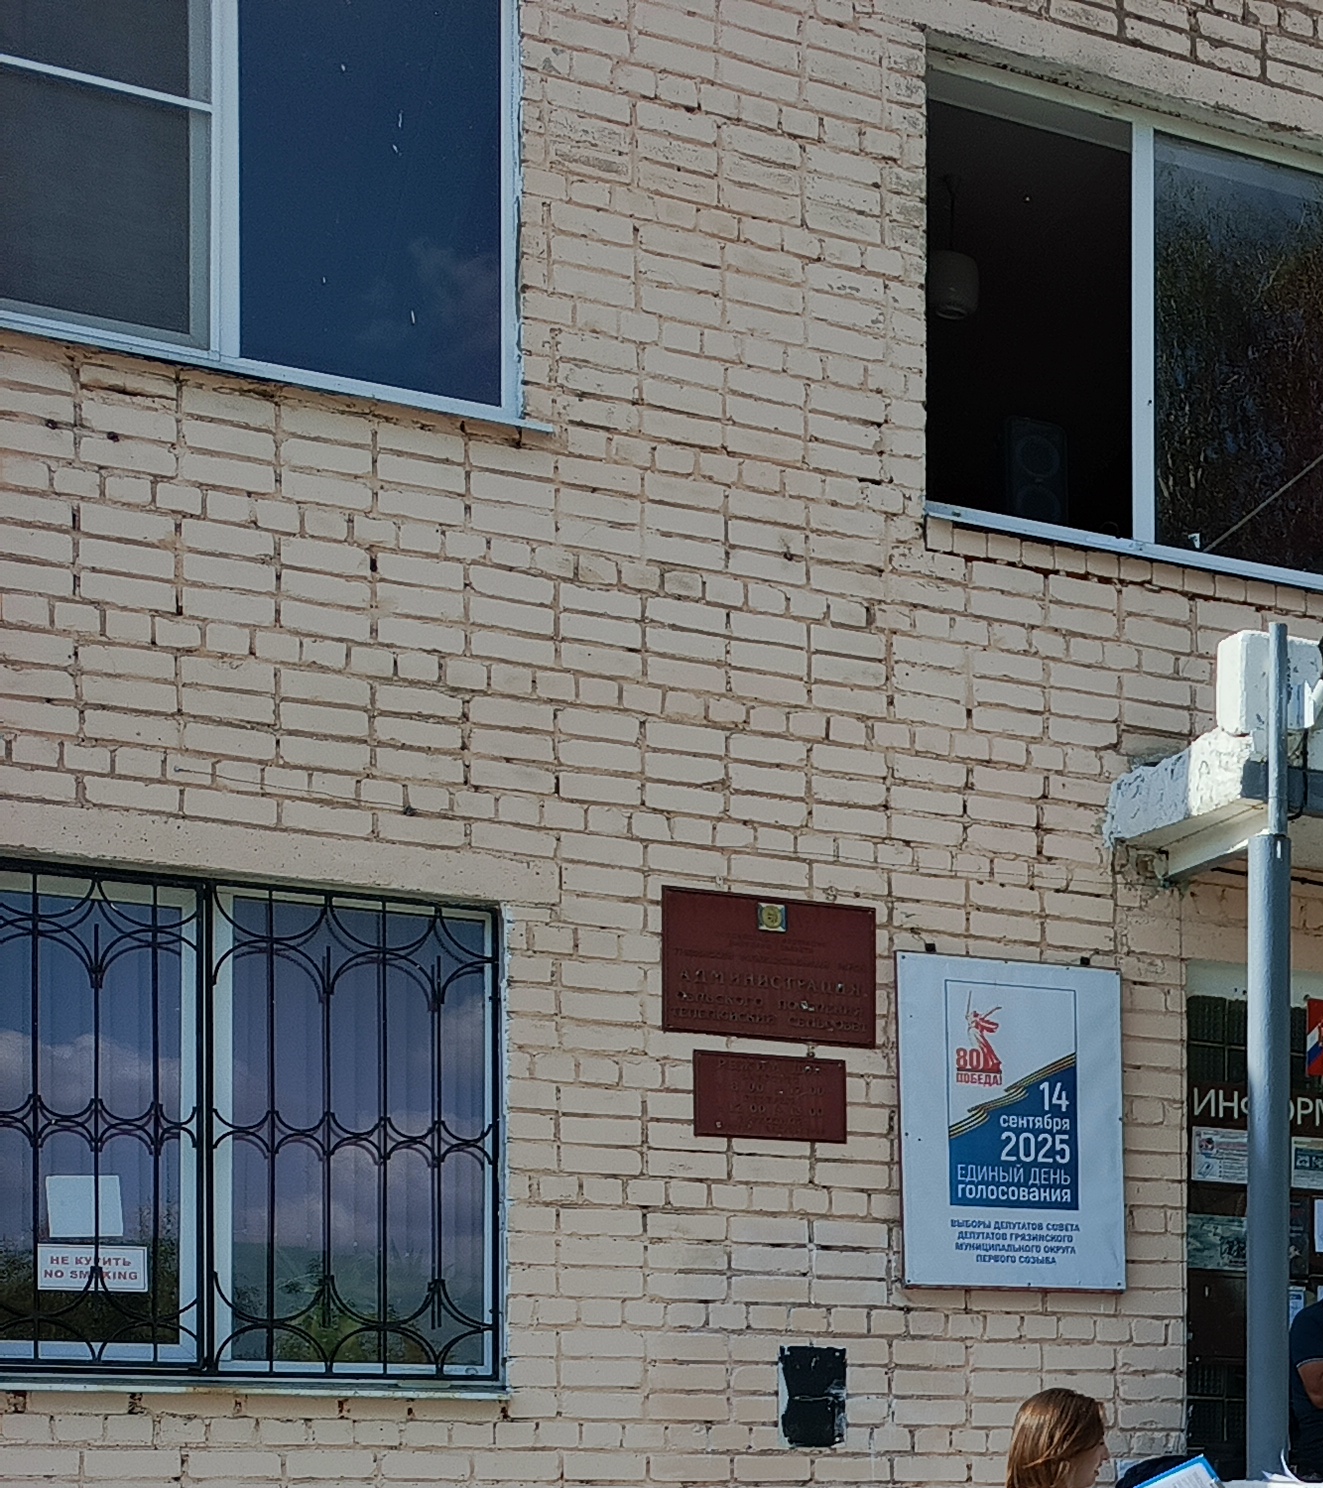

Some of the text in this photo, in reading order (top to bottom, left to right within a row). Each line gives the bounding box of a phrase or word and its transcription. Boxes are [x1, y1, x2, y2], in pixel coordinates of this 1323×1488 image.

[680, 969, 861, 996] АДМИНИСТРАЦИЯ
[956, 1047, 982, 1070] 80
[1039, 1081, 1070, 1112] 14
[1000, 1114, 1070, 1132] сентября
[1000, 1131, 1070, 1164] 2025
[957, 1163, 1071, 1186] ЕДИНЫЙ ДЕНЬ
[957, 1183, 1071, 1203] голосования
[950, 1219, 1080, 1232] ВЫБОРЫ ДЕПУТАТОВ СОВЕТА
[957, 1230, 1073, 1243] ДЕПУТАТОВ ГРЯЗИНСКОГО
[955, 1241, 1076, 1255] МУНИЦИПАЛЬНОГО ОКРУГА
[50, 1255, 132, 1267] НЕ КУИТЬ
[976, 1254, 1016, 1264] ПЕРВОГО
[44, 1269, 138, 1280] NO SMKING
